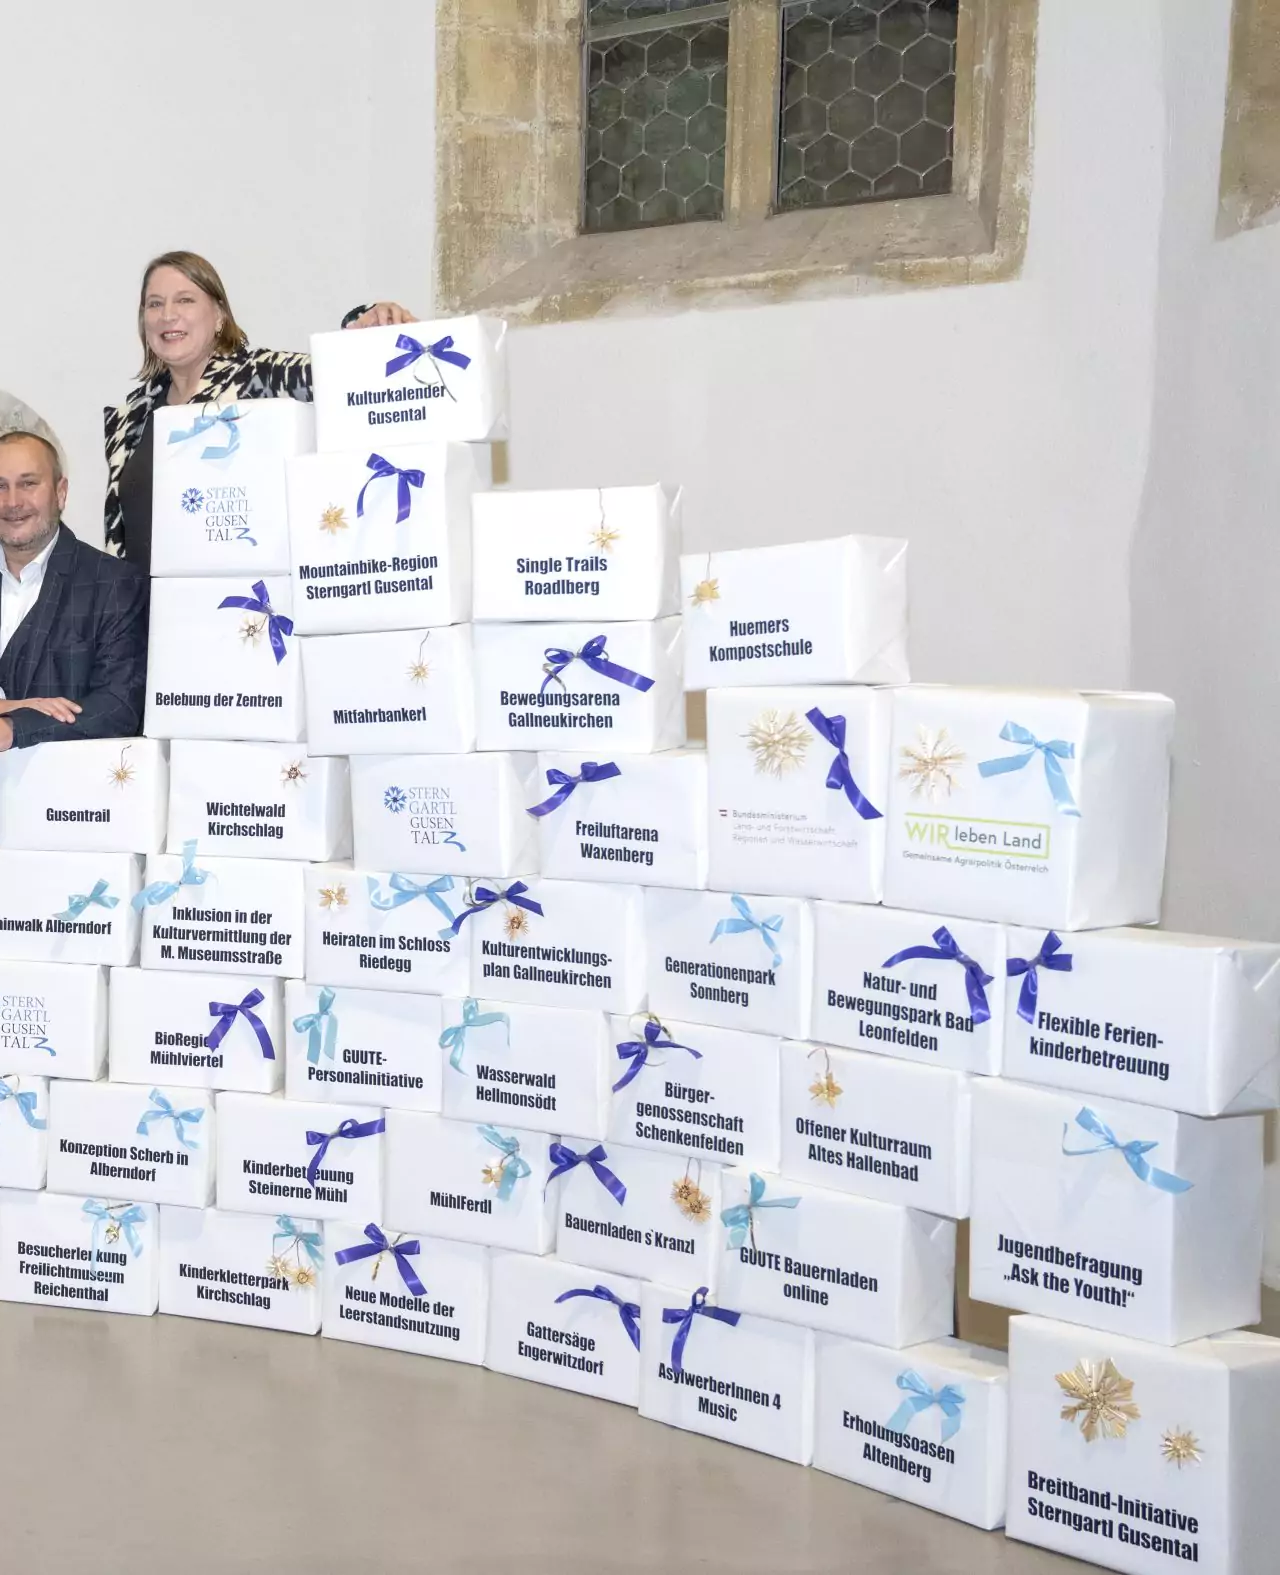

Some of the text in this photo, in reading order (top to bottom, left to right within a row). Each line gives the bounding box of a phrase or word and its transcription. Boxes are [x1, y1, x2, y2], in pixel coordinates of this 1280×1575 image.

[347, 383, 445, 407] Kulturkalender
[368, 406, 426, 425] Gusental
[206, 487, 246, 498] STERN
[205, 501, 253, 513] GARTL
[205, 515, 248, 528] GUSEN
[300, 554, 438, 579] Mountainbike-Region
[517, 556, 608, 575] Single Trails
[307, 576, 433, 601] Sterngartl Gusental
[525, 578, 600, 596] Roadlberg
[730, 618, 789, 636] Huemers
[710, 639, 812, 663] Kompostschule
[156, 692, 282, 709] Belebung der Zentren
[500, 691, 620, 709] Bewegungsarena
[333, 707, 427, 725] Mitfahrbankerl
[508, 711, 613, 729] Gallneukirchen
[46, 807, 110, 823] Gusentrail
[206, 802, 286, 820] Wichtelwald
[208, 822, 283, 840] Kirchschlag
[576, 820, 658, 842] Freiluftarena
[904, 819, 1042, 851] WIR leben Land
[580, 843, 653, 866] Waxenberg
[903, 850, 1049, 874] Gemeinsame Agrarpolitik Österreich
[45, 919, 112, 936] Alberndorf
[482, 940, 613, 967] Kulturentwicklungs-
[483, 963, 612, 990] plan Gallneukirchen
[665, 957, 776, 987] Generationenpark
[690, 983, 749, 1008] Sonnberg
[1038, 1011, 1164, 1049] Flexible Ferien-
[150, 1050, 223, 1068] Mühlviertel
[343, 1048, 387, 1066] GUUTE-
[1029, 1036, 1170, 1081] kinderbetreuung
[308, 1066, 424, 1091] Personalinitiative
[476, 1064, 556, 1090] Wasserwald
[476, 1086, 557, 1112] Hellmonsödt
[665, 1081, 715, 1105] Bürger-
[636, 1102, 744, 1133] genossenschaft
[635, 1122, 744, 1156] Schenkenfelden
[796, 1116, 932, 1161] Offener Kulturraum
[59, 1139, 188, 1166] Konzeption Scherb in
[808, 1143, 919, 1183] Altes Hallenbad
[90, 1161, 156, 1182] Alberndorf
[249, 1179, 347, 1203] Steinerne Mühl
[430, 1191, 492, 1214] MühlFerdl
[565, 1213, 642, 1245] Bauernladen
[19, 1260, 125, 1283] Freilichtmuseum
[740, 1247, 878, 1292] GUUTE Bauernladen
[997, 1233, 1143, 1286] Jugendbefragung
[179, 1263, 290, 1291] Kinderkletterpark
[1043, 1272, 1070, 1299] the
[34, 1283, 109, 1302] Reichenthal
[197, 1284, 271, 1309] Kirchschlag
[783, 1282, 829, 1306] online
[527, 1321, 595, 1352] Gattersäge
[518, 1340, 604, 1376] Engerwitzdorf
[658, 1363, 781, 1410] AsylwerberInnen 4
[698, 1397, 737, 1422] Music
[843, 1410, 955, 1464] Erholungsoasen
[863, 1443, 931, 1483] Altenberg
[1027, 1469, 1199, 1534] Breitband-Initiative
[1027, 1496, 1199, 1562] Sterngartl Gusental
